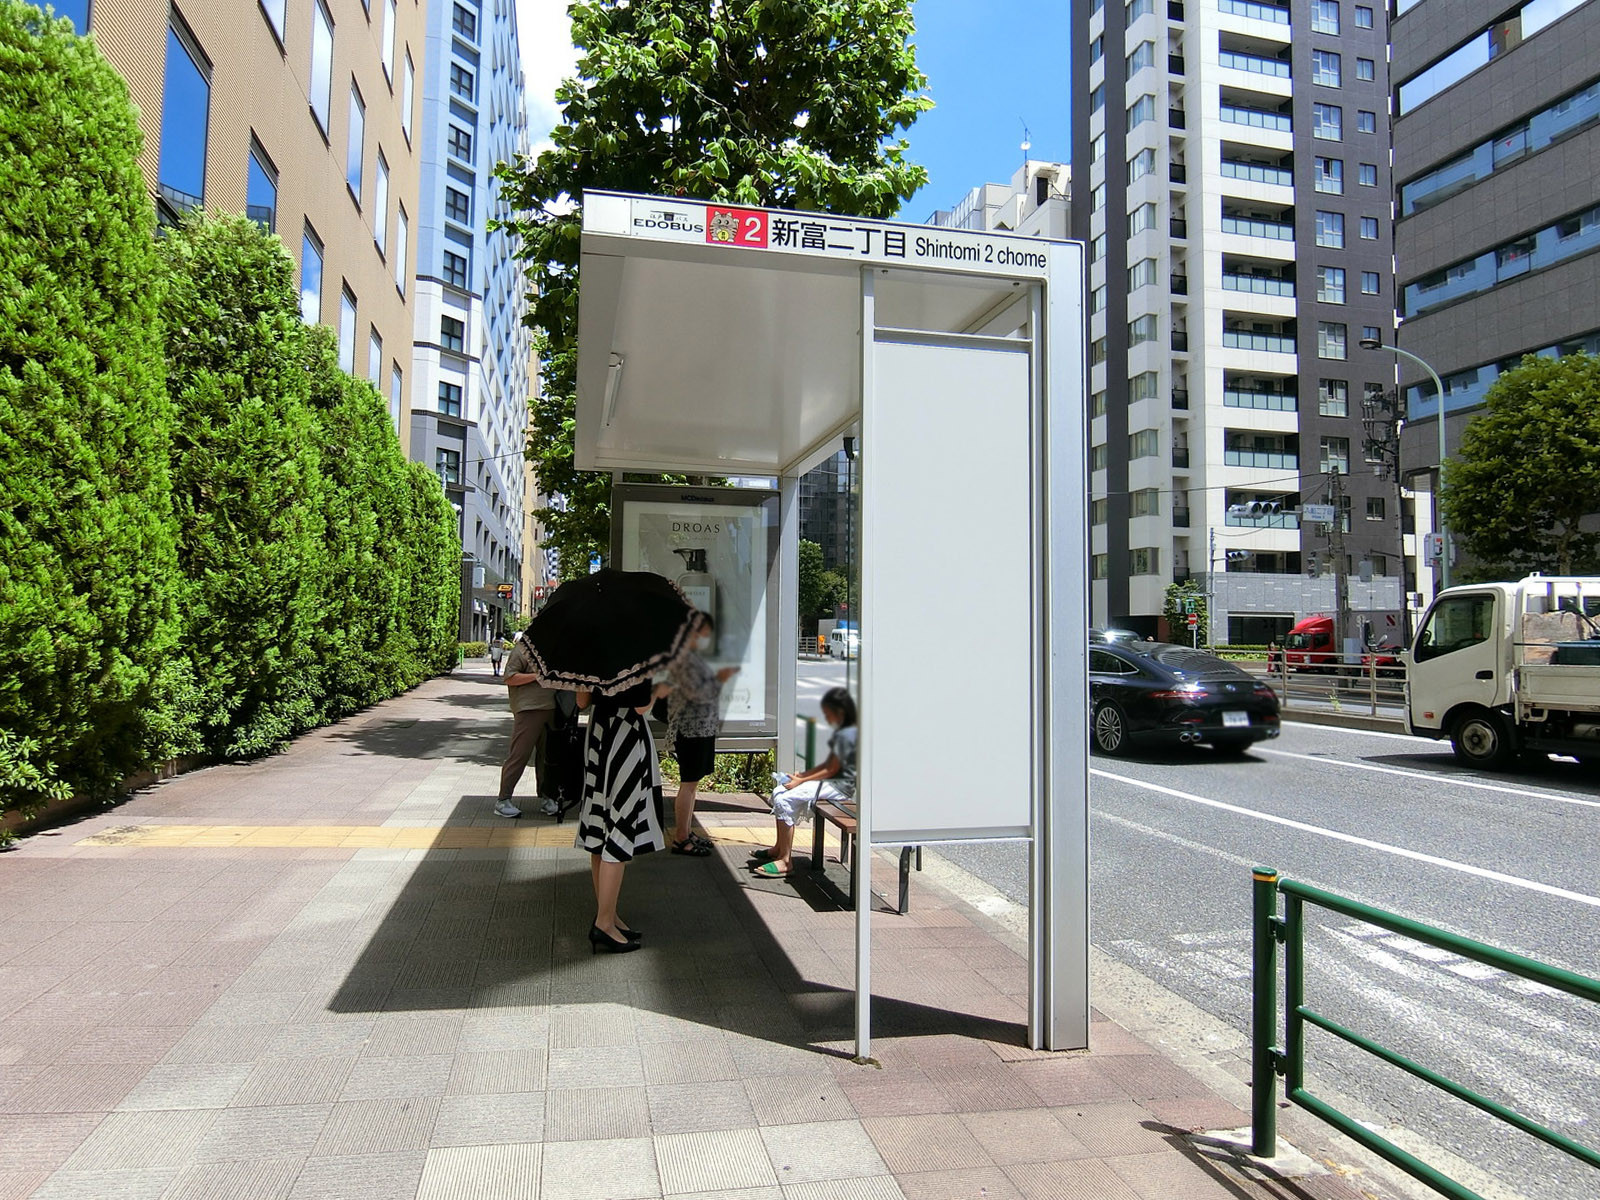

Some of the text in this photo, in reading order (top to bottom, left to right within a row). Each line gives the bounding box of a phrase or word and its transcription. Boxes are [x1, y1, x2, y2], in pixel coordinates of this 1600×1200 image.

[633, 218, 704, 233] EDOBUS
[744, 216, 761, 242] 2
[771, 218, 906, 258] 新富二丁目
[915, 237, 1047, 268] Shintomi 2 chome
[672, 522, 720, 534] DROAS
